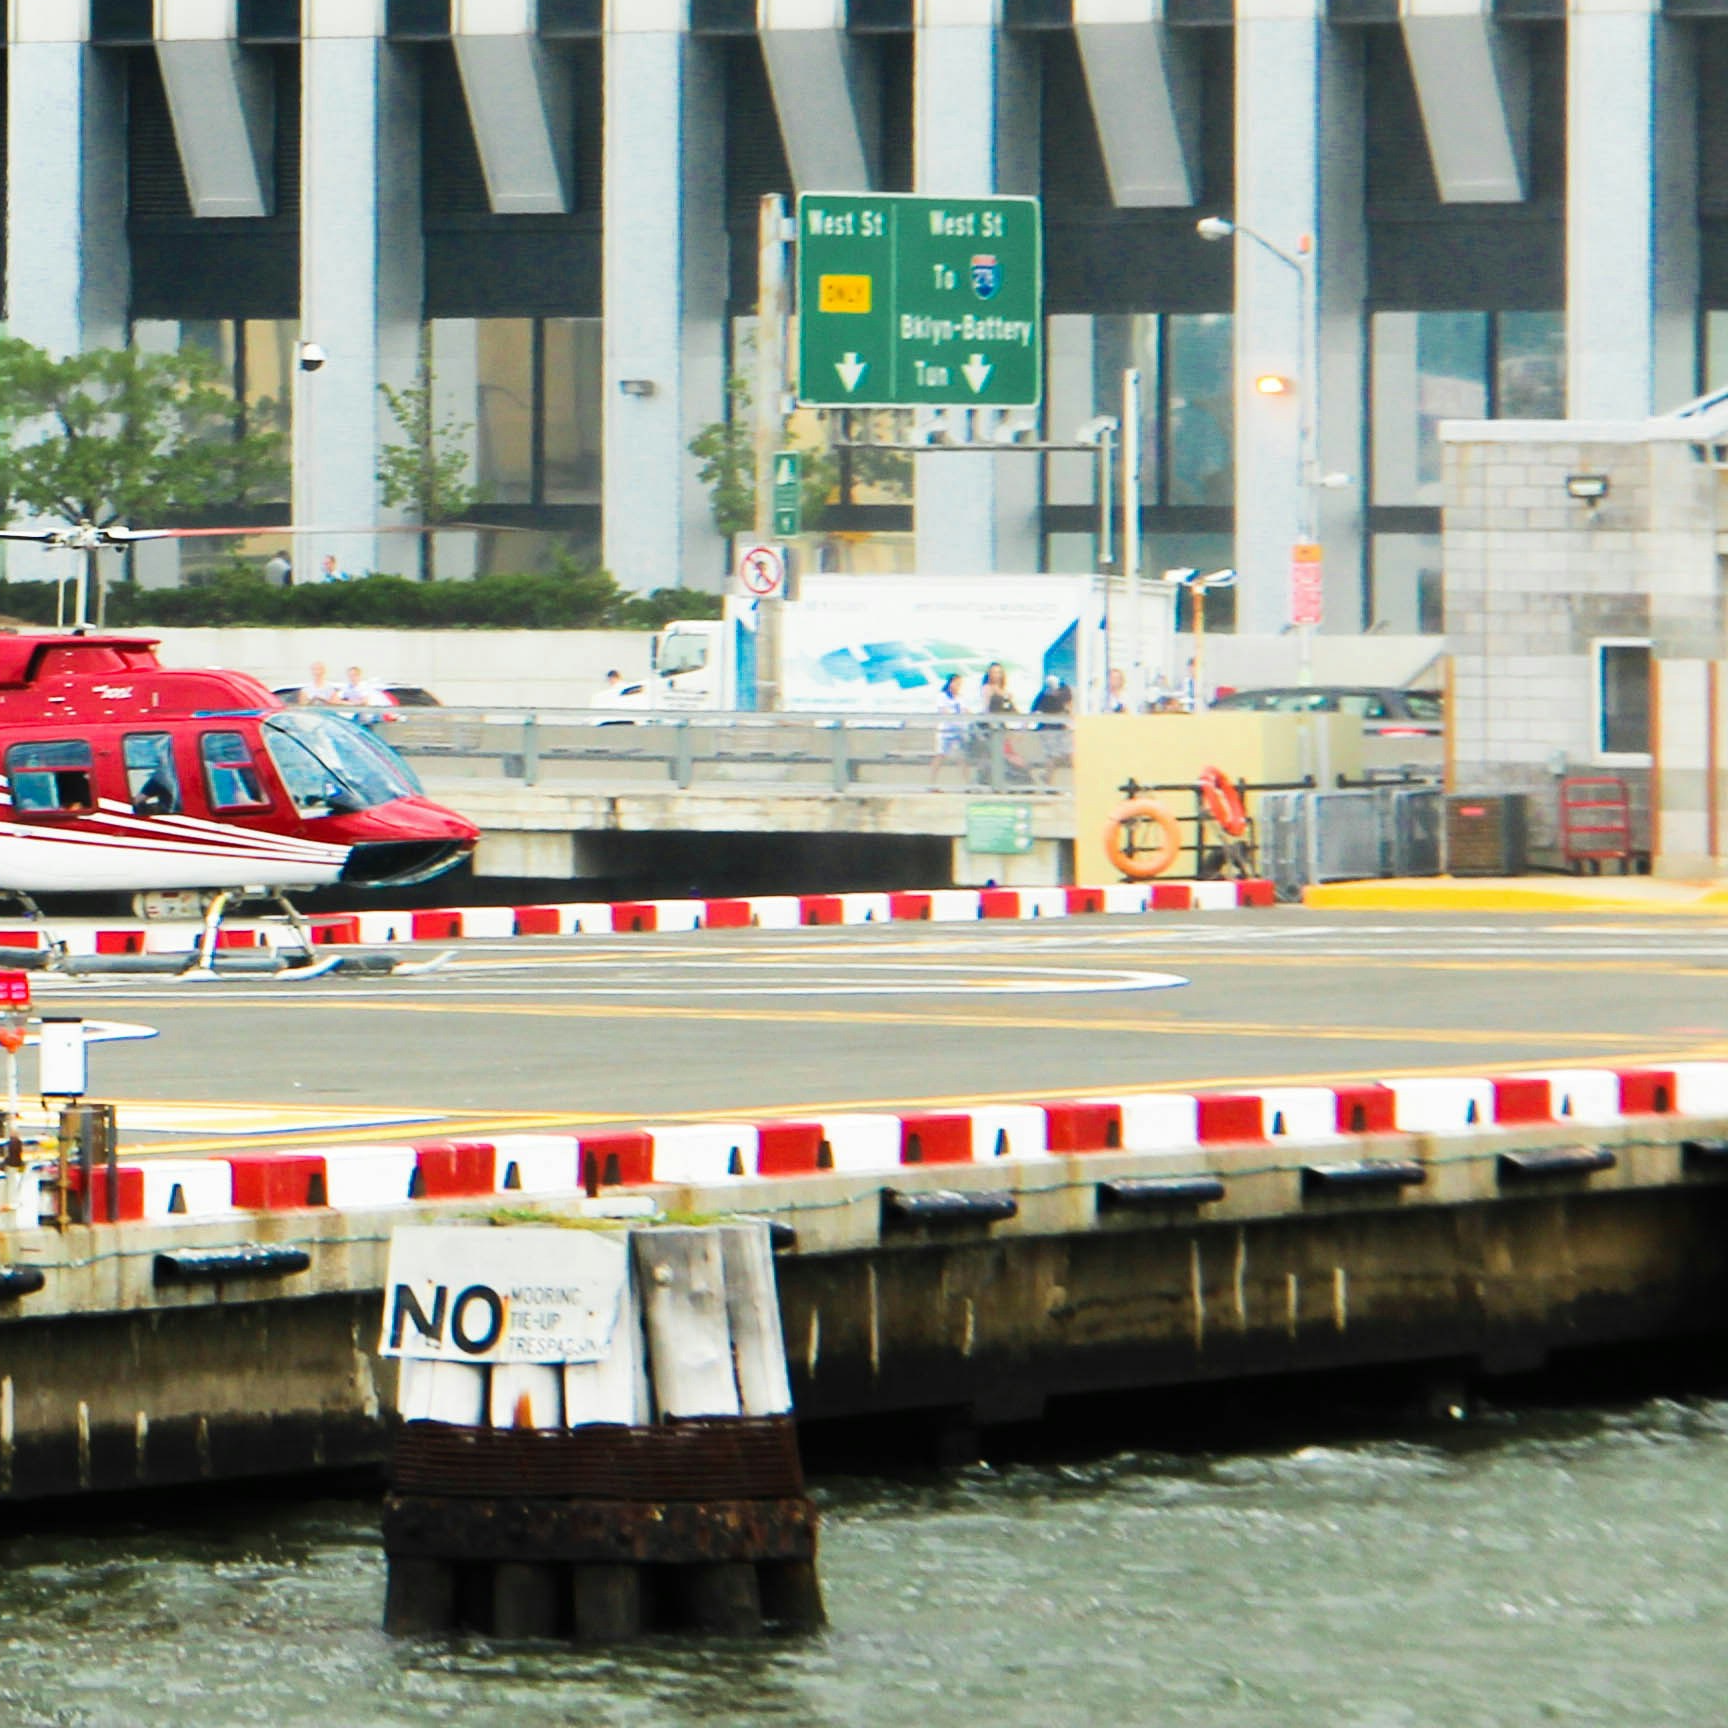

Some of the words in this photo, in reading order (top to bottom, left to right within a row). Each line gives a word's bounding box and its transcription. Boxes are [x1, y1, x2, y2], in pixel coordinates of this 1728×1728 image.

[808, 209, 855, 235] West
[860, 210, 884, 237] St
[929, 210, 975, 236] West
[981, 210, 1004, 237] St
[933, 264, 956, 289] To
[900, 314, 1032, 347] Bklyn-Battery
[390, 1284, 504, 1355] NO
